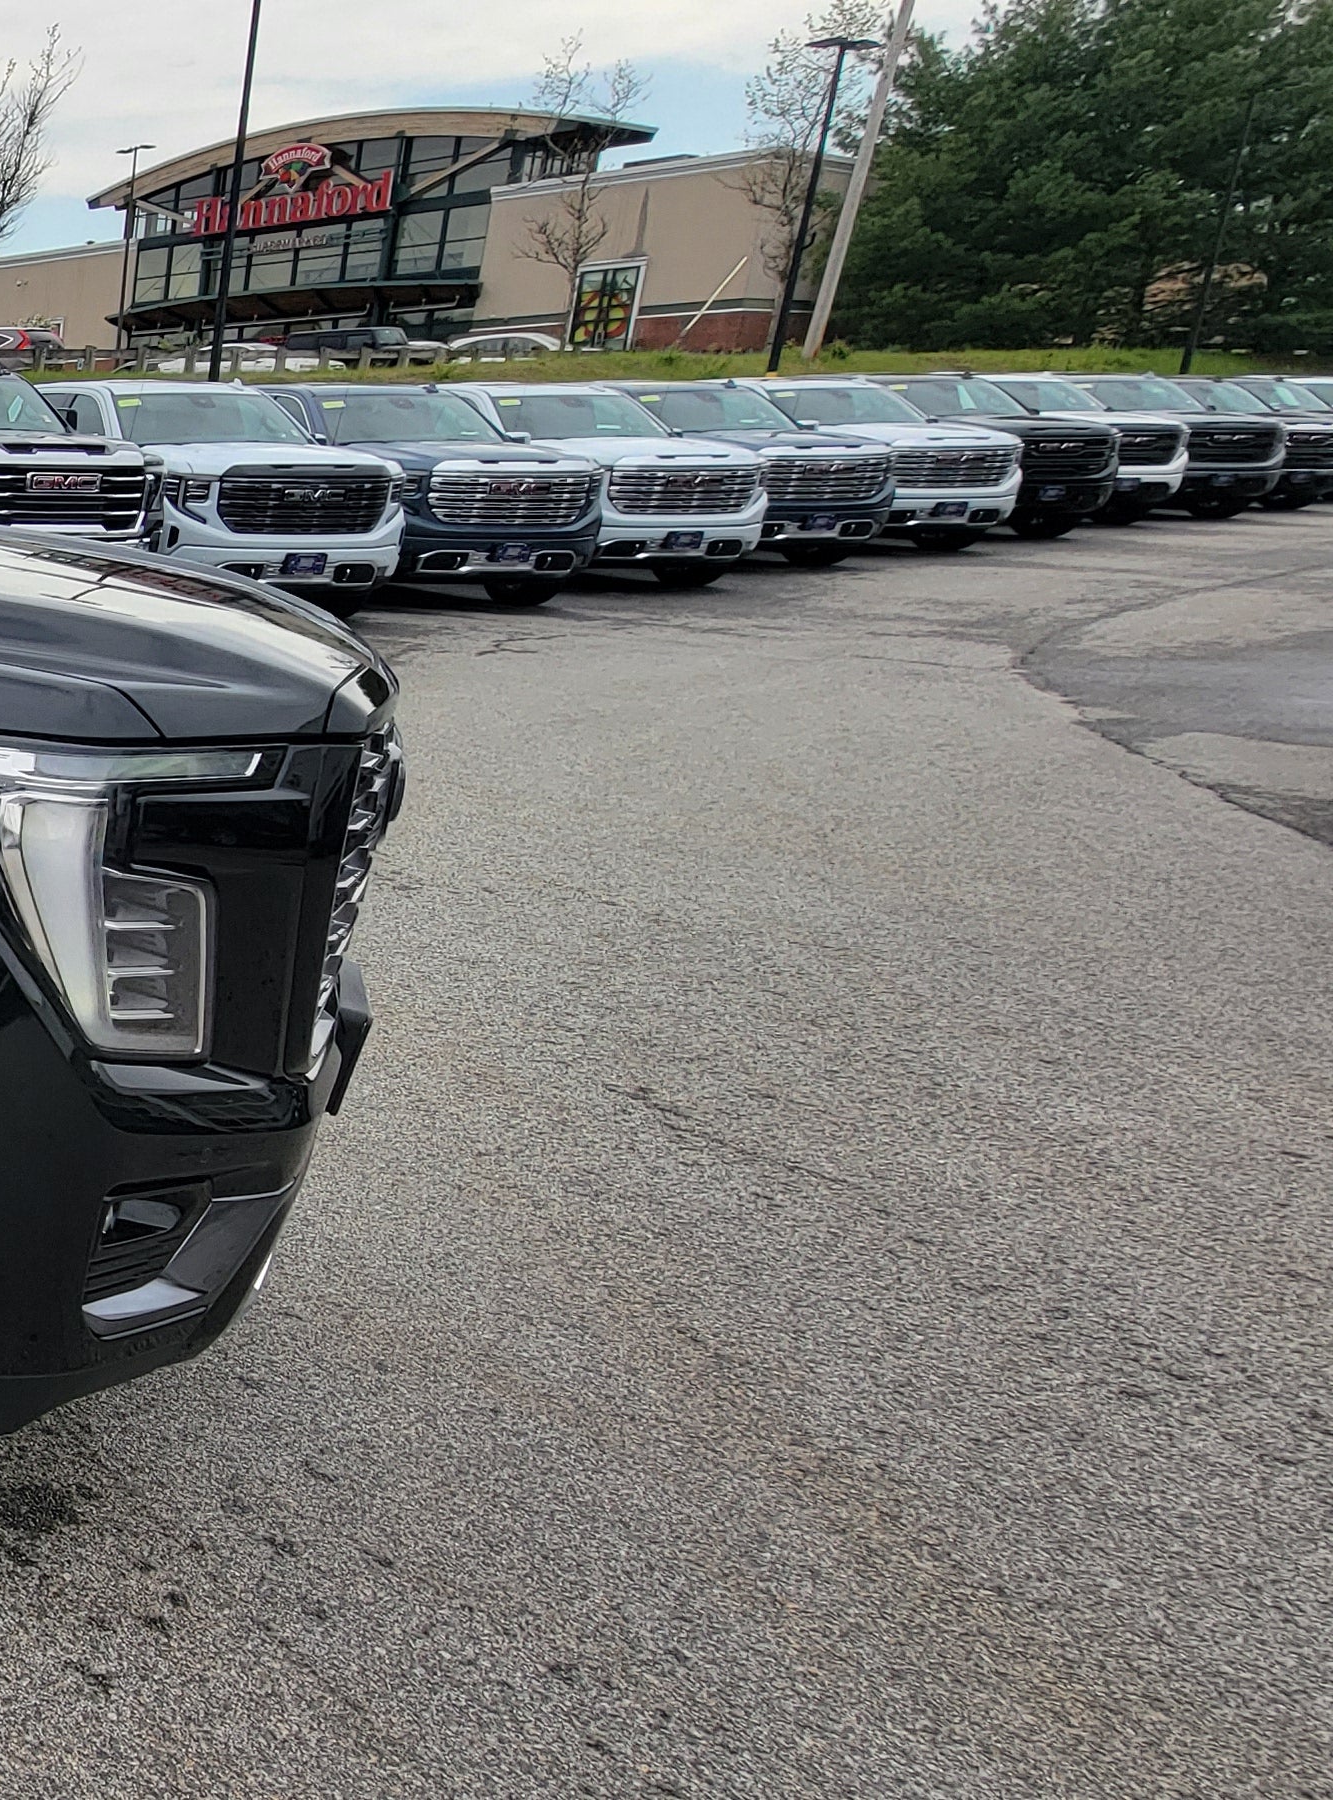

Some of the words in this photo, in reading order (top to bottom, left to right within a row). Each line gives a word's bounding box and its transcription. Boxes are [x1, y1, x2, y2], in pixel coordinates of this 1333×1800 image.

[268, 147, 322, 169] Hannaford
[33, 475, 98, 490] GMC
[284, 489, 346, 501] GMC
